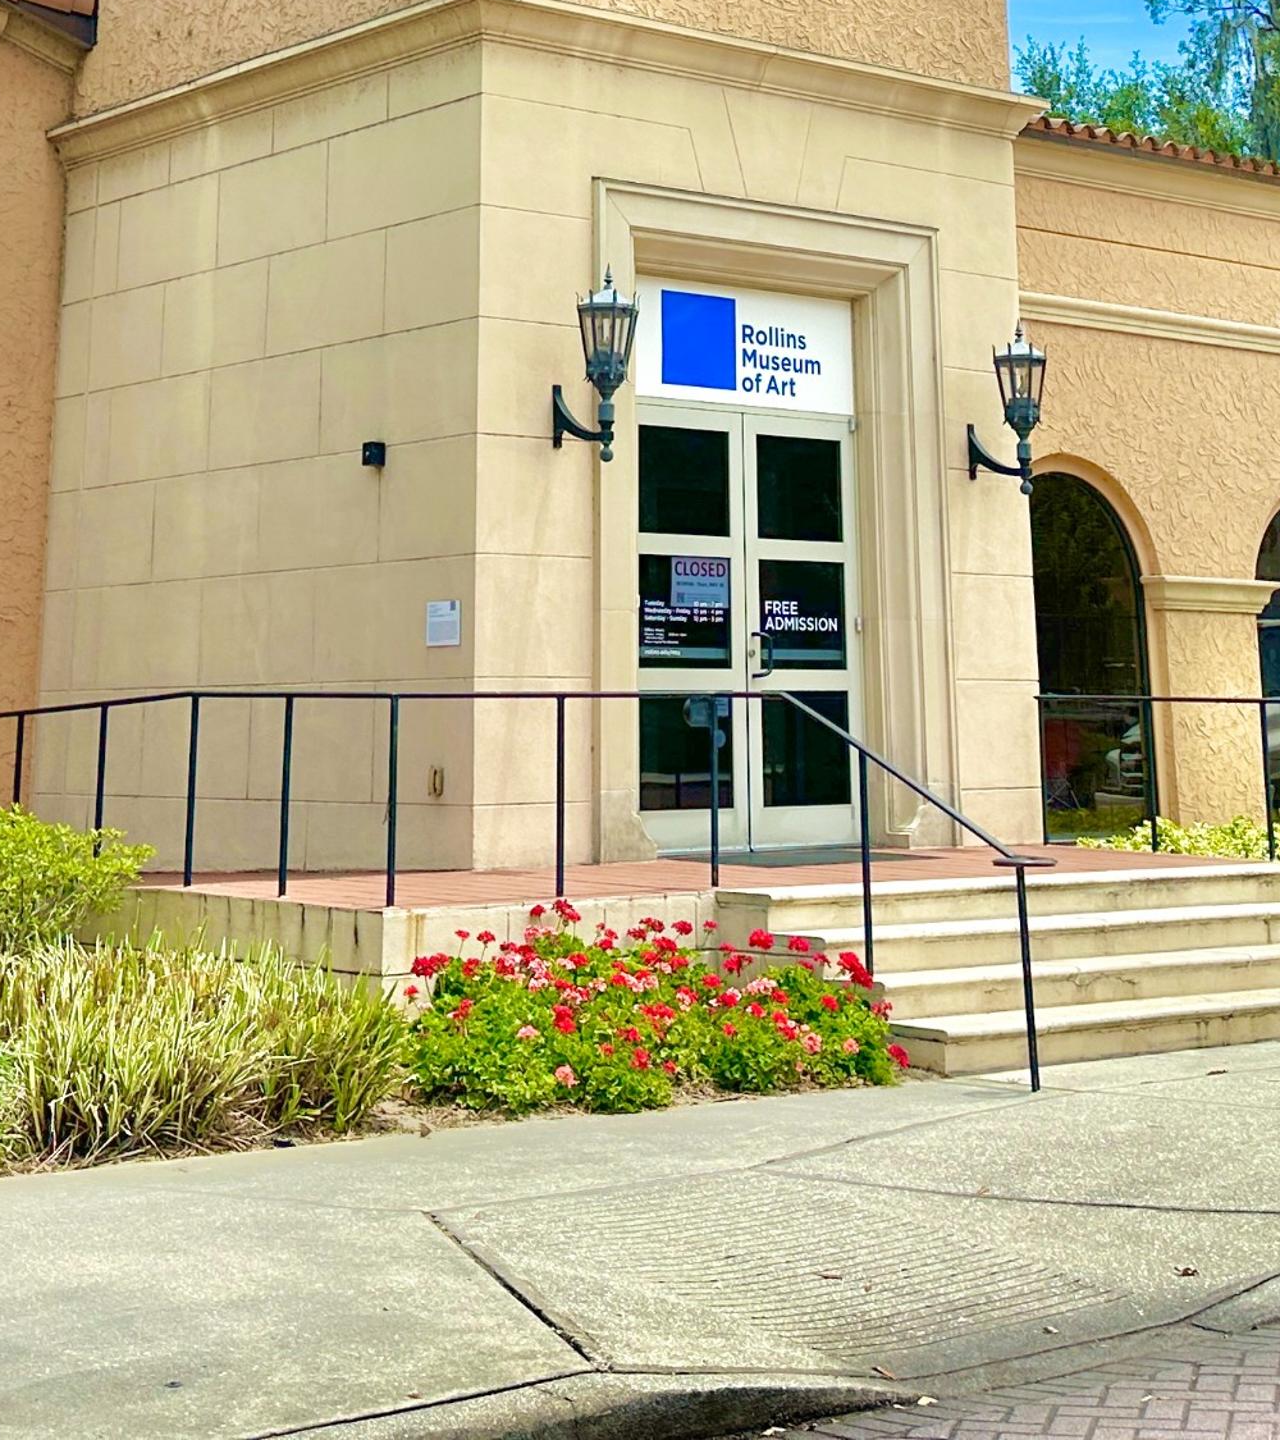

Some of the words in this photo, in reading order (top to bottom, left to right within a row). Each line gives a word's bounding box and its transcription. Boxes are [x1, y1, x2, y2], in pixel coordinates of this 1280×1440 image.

[741, 324, 807, 350] Rollins
[742, 348, 821, 375] Museum
[742, 373, 762, 393] of
[766, 375, 796, 397] Art
[674, 561, 726, 577] CLOSED
[764, 600, 799, 615] FREE
[764, 616, 838, 632] ADMISSION
